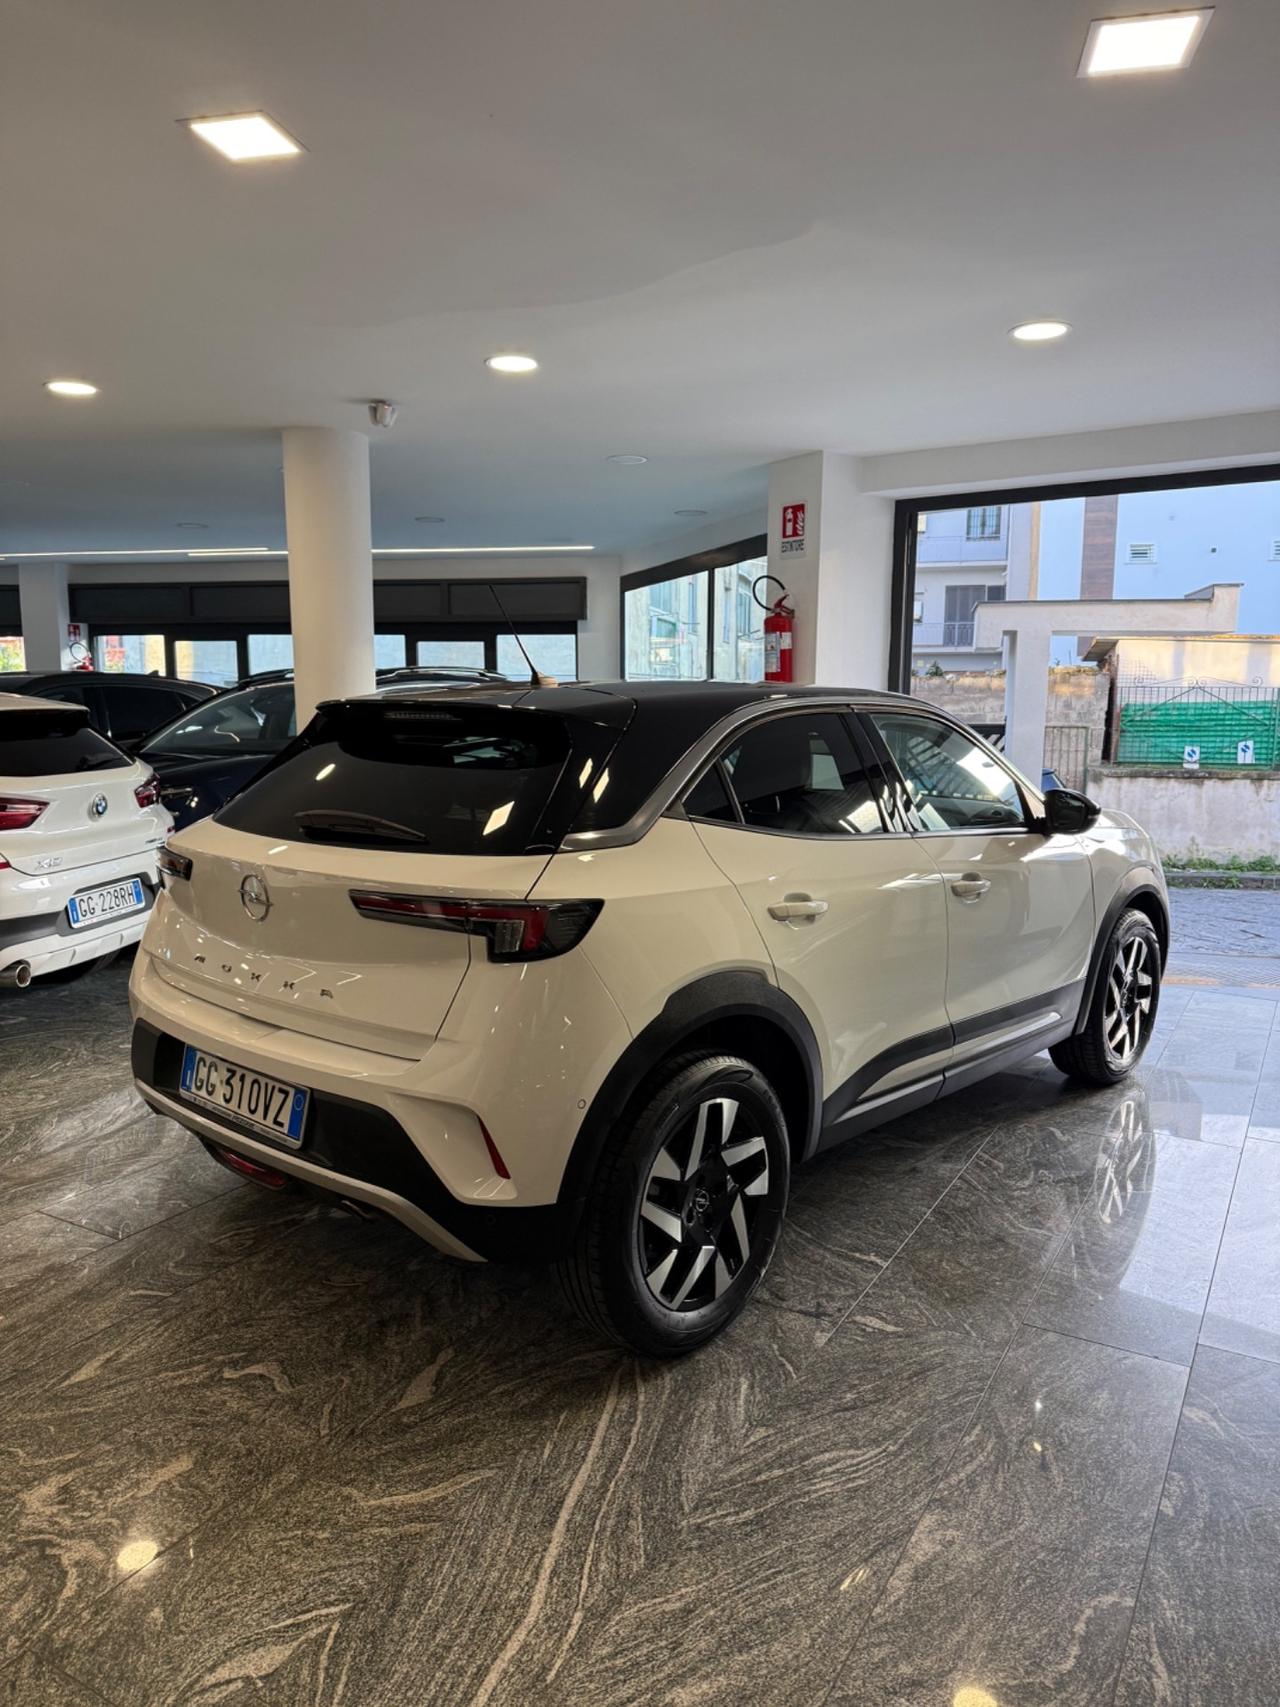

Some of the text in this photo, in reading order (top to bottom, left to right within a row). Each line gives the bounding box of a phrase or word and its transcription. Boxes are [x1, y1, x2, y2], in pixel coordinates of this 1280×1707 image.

[78, 885, 136, 918] GG 228RH
[194, 955, 334, 999] MOKKA
[194, 1056, 218, 1097] GG
[222, 1067, 290, 1128] 310VZ
